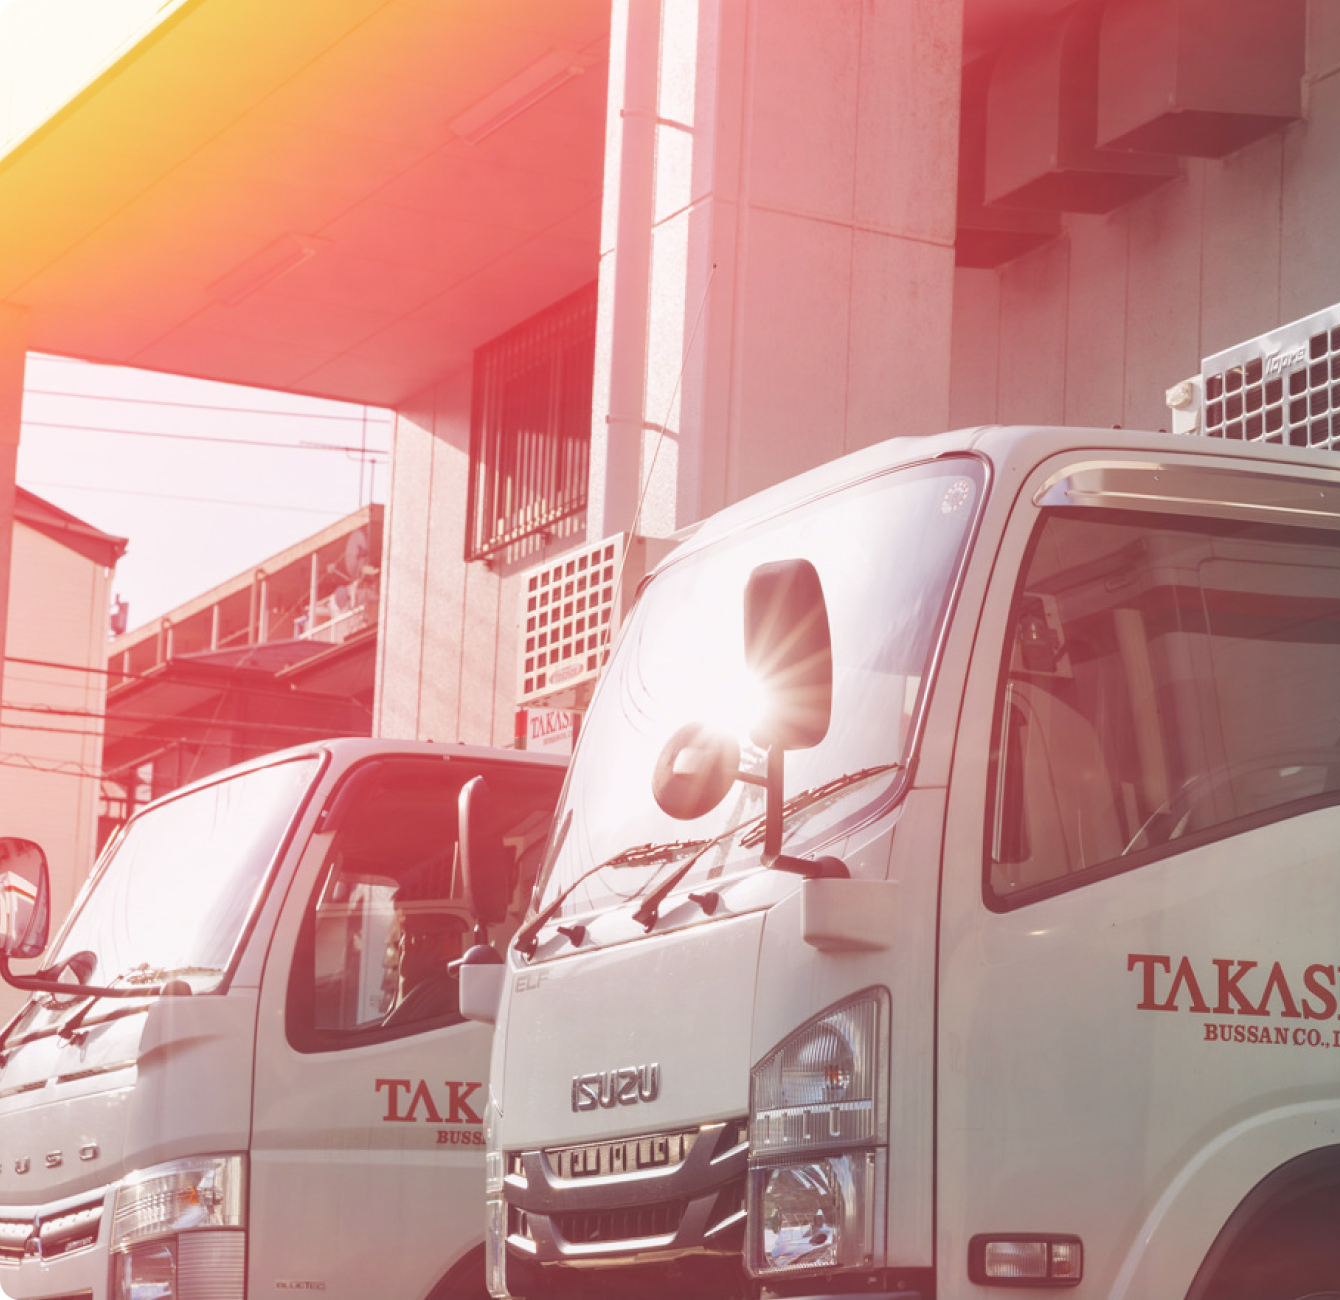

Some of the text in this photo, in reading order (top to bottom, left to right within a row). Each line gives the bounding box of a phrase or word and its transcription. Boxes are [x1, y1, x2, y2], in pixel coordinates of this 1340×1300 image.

[531, 710, 573, 739] TAKAS
[515, 971, 550, 993] ELF
[1203, 1022, 1290, 1046] BUSSAN
[375, 1078, 484, 1124] TAK
[571, 1062, 661, 1113] ISUZU
[436, 1130, 487, 1146] BUSS
[0, 1142, 99, 1176] USO
